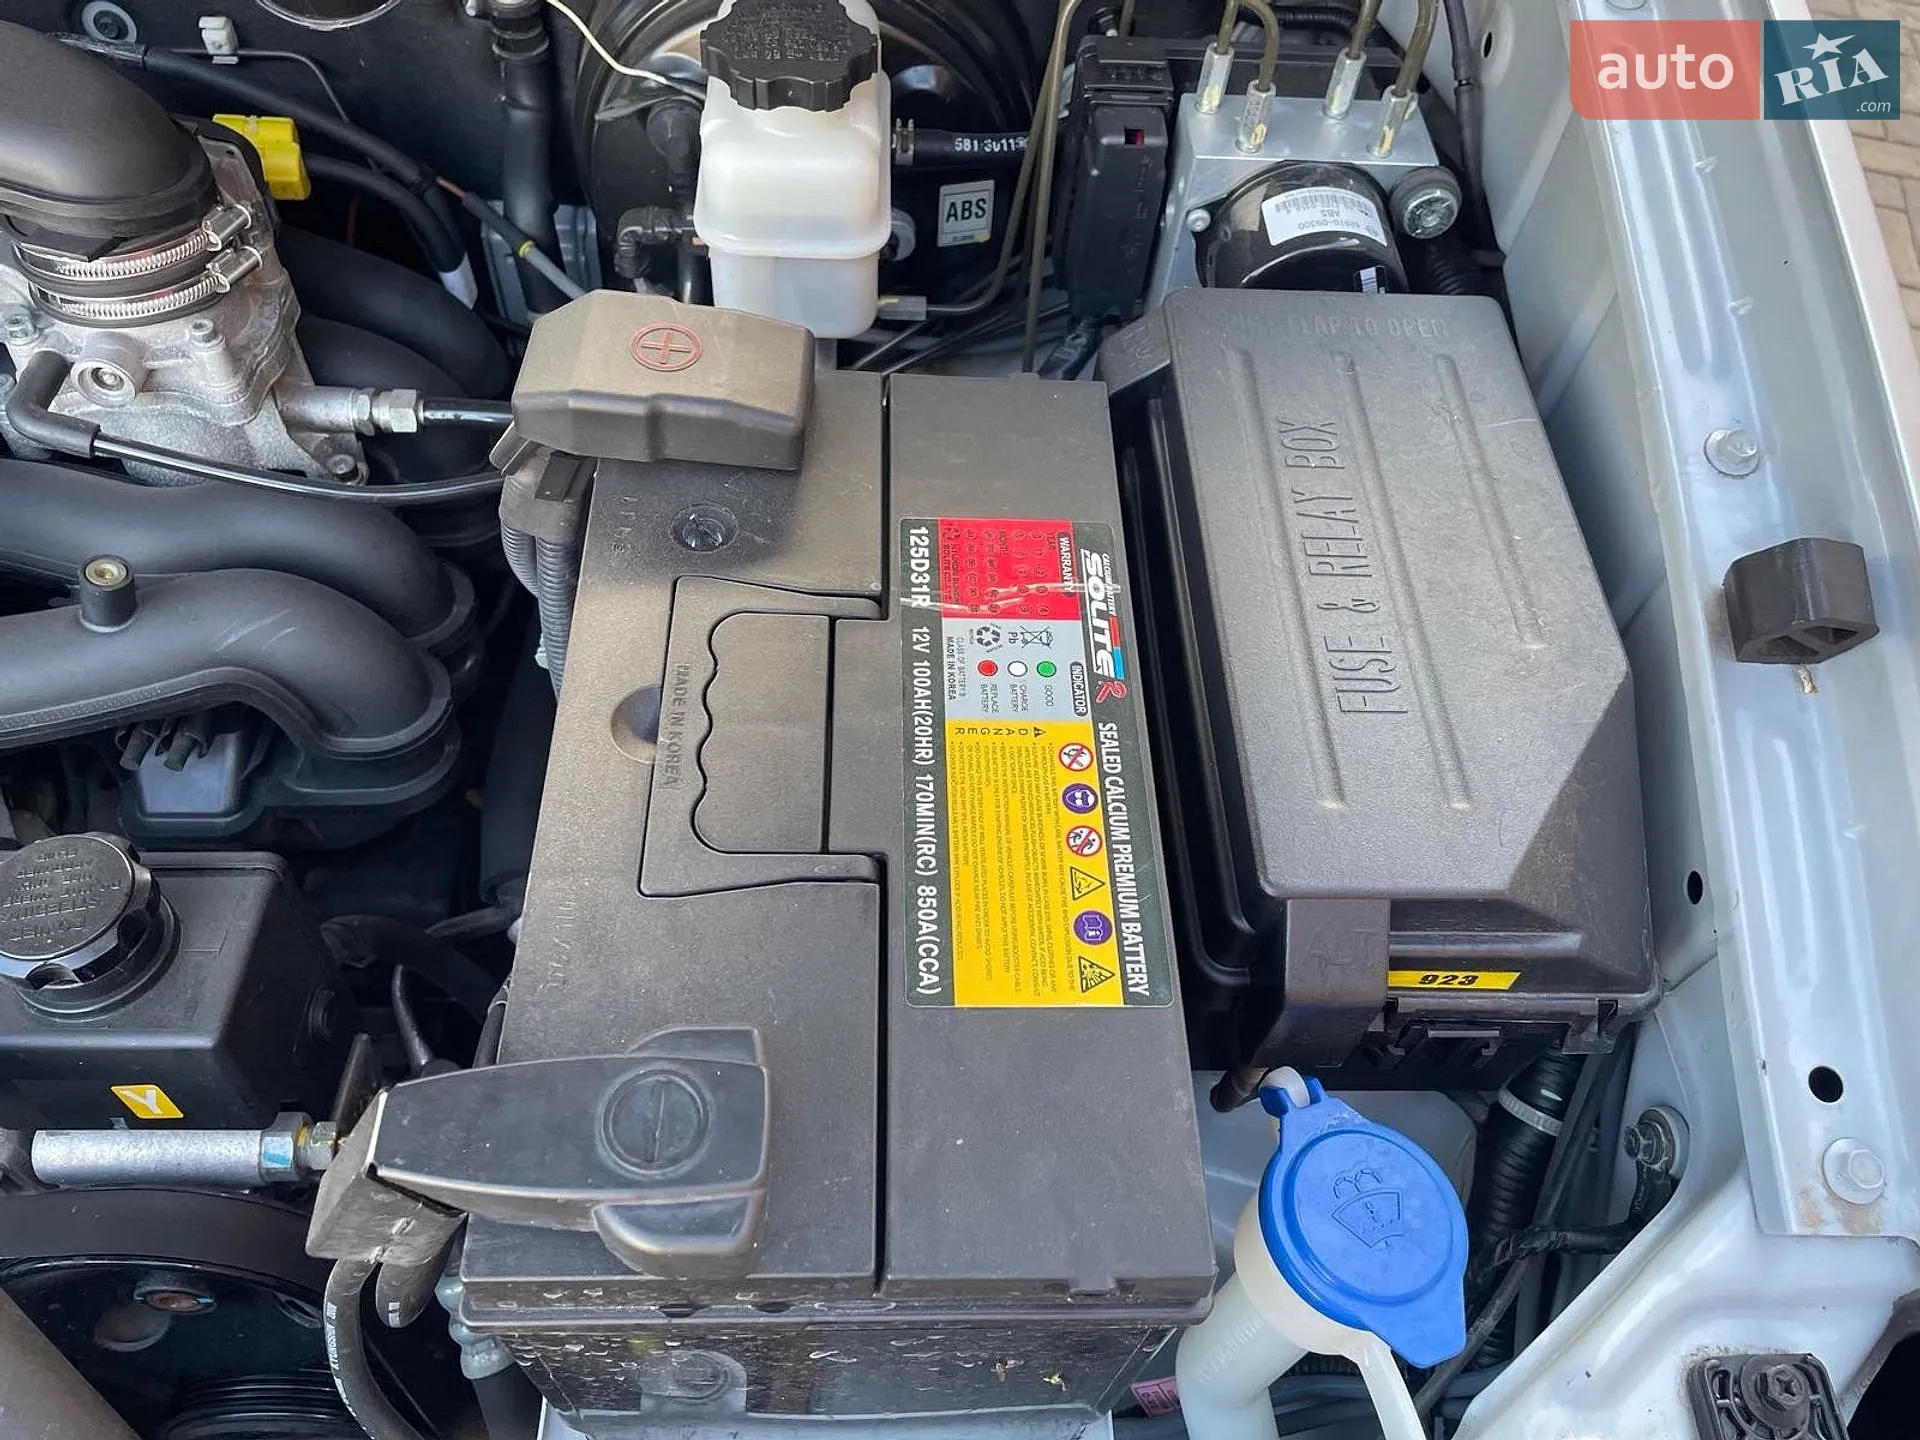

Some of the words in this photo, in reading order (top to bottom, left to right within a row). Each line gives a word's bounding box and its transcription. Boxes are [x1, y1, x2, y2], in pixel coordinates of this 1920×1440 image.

[945, 197, 988, 224] ABS
[1387, 316, 1449, 338] OPEN
[1276, 418, 1346, 470] BOX
[1291, 486, 1373, 578] RELAY
[908, 526, 931, 608] 125D31R
[1058, 536, 1074, 594] WARRANTY
[1082, 549, 1116, 679] SOLITE
[1316, 596, 1381, 614] &
[911, 626, 931, 653] 12V
[946, 636, 956, 659] MADE
[1007, 631, 1020, 645] Pb
[946, 660, 956, 671] IN
[1323, 634, 1409, 714] FUSE
[671, 663, 690, 708] MADE
[947, 671, 957, 701] KOREA
[980, 683, 989, 713] BATTERY
[991, 683, 1000, 714] REPLACE
[1009, 684, 1019, 712] BATTERY
[1019, 684, 1029, 712] CHARGE
[1043, 684, 1054, 707] GOOD
[1070, 665, 1087, 714] INDICATOR
[1095, 680, 1128, 704] R
[669, 711, 686, 727] IN
[911, 660, 936, 766] 100AH(20HR)
[662, 731, 684, 789] KOREA
[1097, 722, 1122, 774] SEALED
[1104, 775, 1130, 843] CALCIUM
[913, 774, 939, 876] 170MIN(RC)
[1110, 843, 1138, 918] PREMIUM
[915, 885, 942, 995] 850A(CCA)
[1120, 922, 1151, 996] BATTERY
[1418, 973, 1480, 987] 923
[117, 1088, 164, 1115] Y
